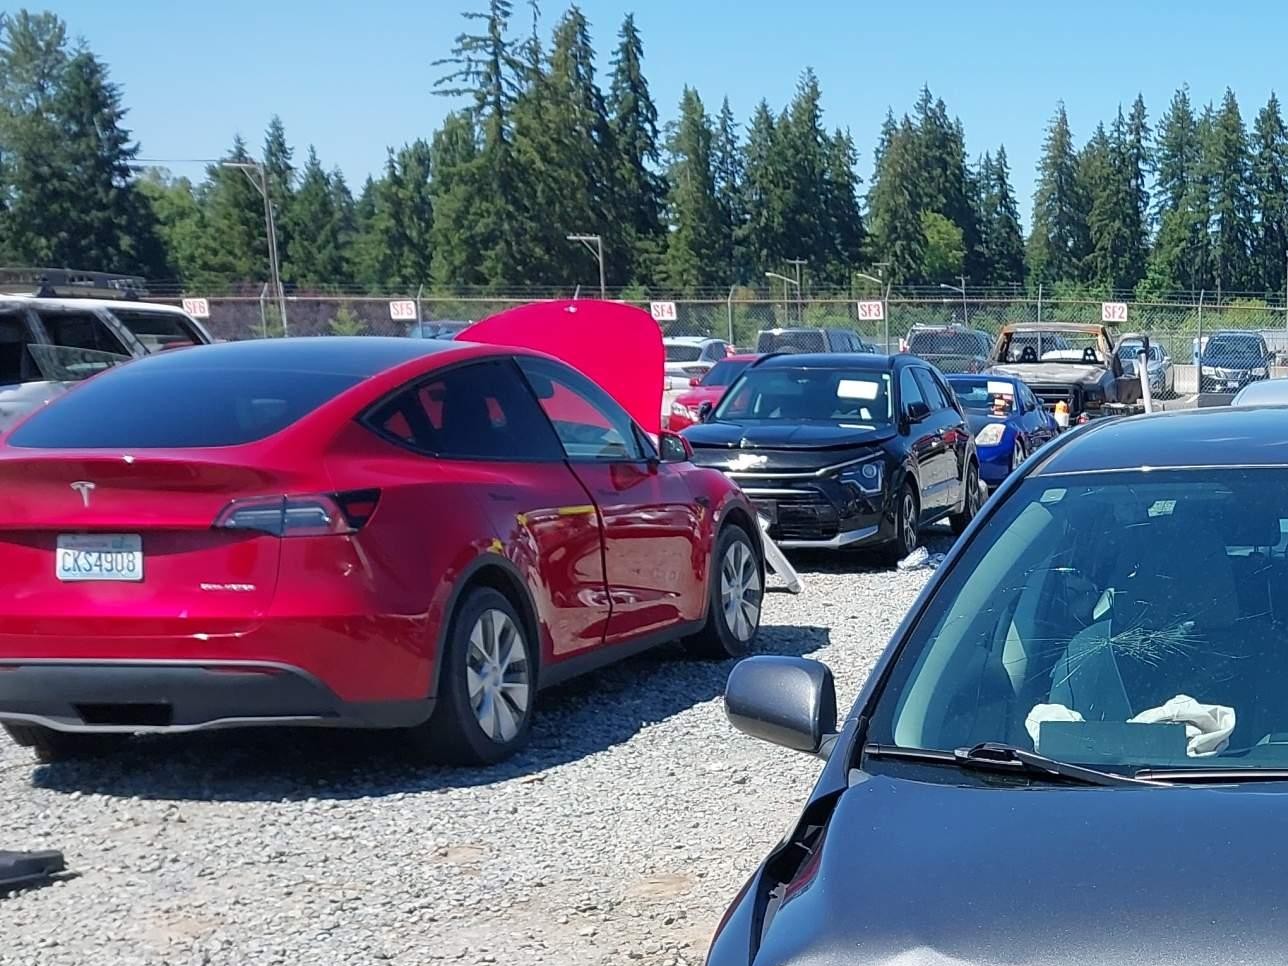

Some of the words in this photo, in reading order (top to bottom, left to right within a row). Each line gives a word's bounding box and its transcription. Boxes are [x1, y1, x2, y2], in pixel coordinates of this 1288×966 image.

[185, 300, 206, 317] SF6
[392, 302, 414, 316] SF5
[652, 303, 674, 317] SF4
[859, 303, 881, 317] SF3
[1104, 305, 1126, 319] SF2
[62, 551, 137, 573] CKS4908
